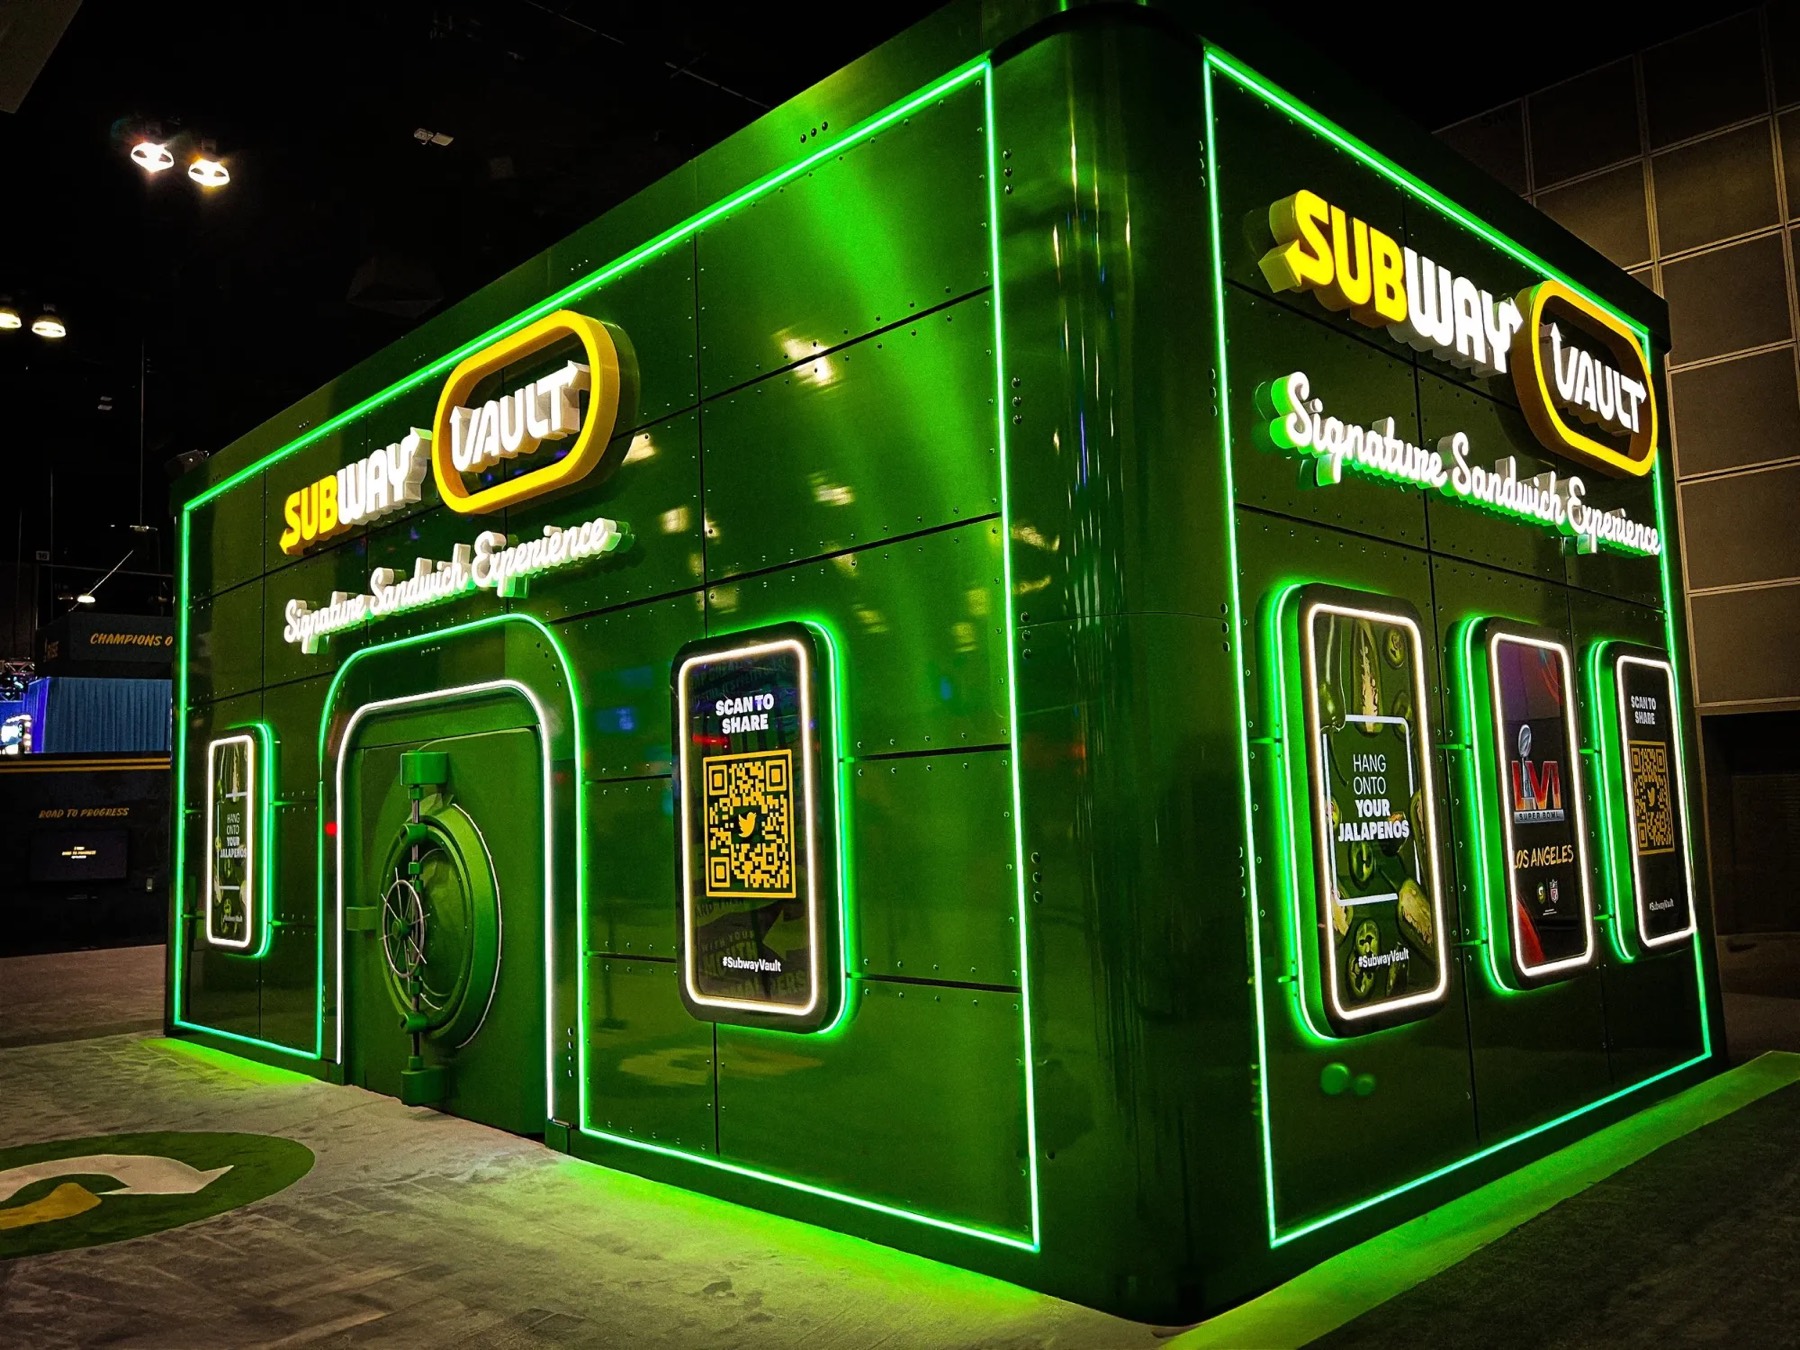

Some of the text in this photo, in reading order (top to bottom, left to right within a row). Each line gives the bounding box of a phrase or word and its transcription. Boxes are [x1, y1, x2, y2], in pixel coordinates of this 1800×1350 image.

[1280, 189, 1648, 434] SUBWAY VAULT
[279, 360, 582, 553] SUBWAY VAULT
[1285, 371, 1661, 554] Signature Sandwich Experience
[284, 517, 617, 654] Signature Sandwich Experience
[89, 632, 162, 648] CHAMPIONS
[715, 693, 775, 717] SCAN TO
[1630, 695, 1657, 710] SCAN TO
[721, 713, 769, 734] SHARE
[1634, 711, 1656, 725] SHARE
[1353, 753, 1387, 773] HANG
[1353, 776, 1387, 796] ONTO
[1511, 760, 1562, 811] LVI
[38, 807, 130, 819] ROAD TO PROGRESS
[1355, 798, 1391, 818] YOUR
[1518, 811, 1560, 821] SUPER BOWL
[1338, 820, 1410, 842] JALAPENOS
[1530, 844, 1574, 867] ANGELES
[722, 956, 781, 973] #SubwayVault
[1358, 946, 1410, 969] #SubwayVault
